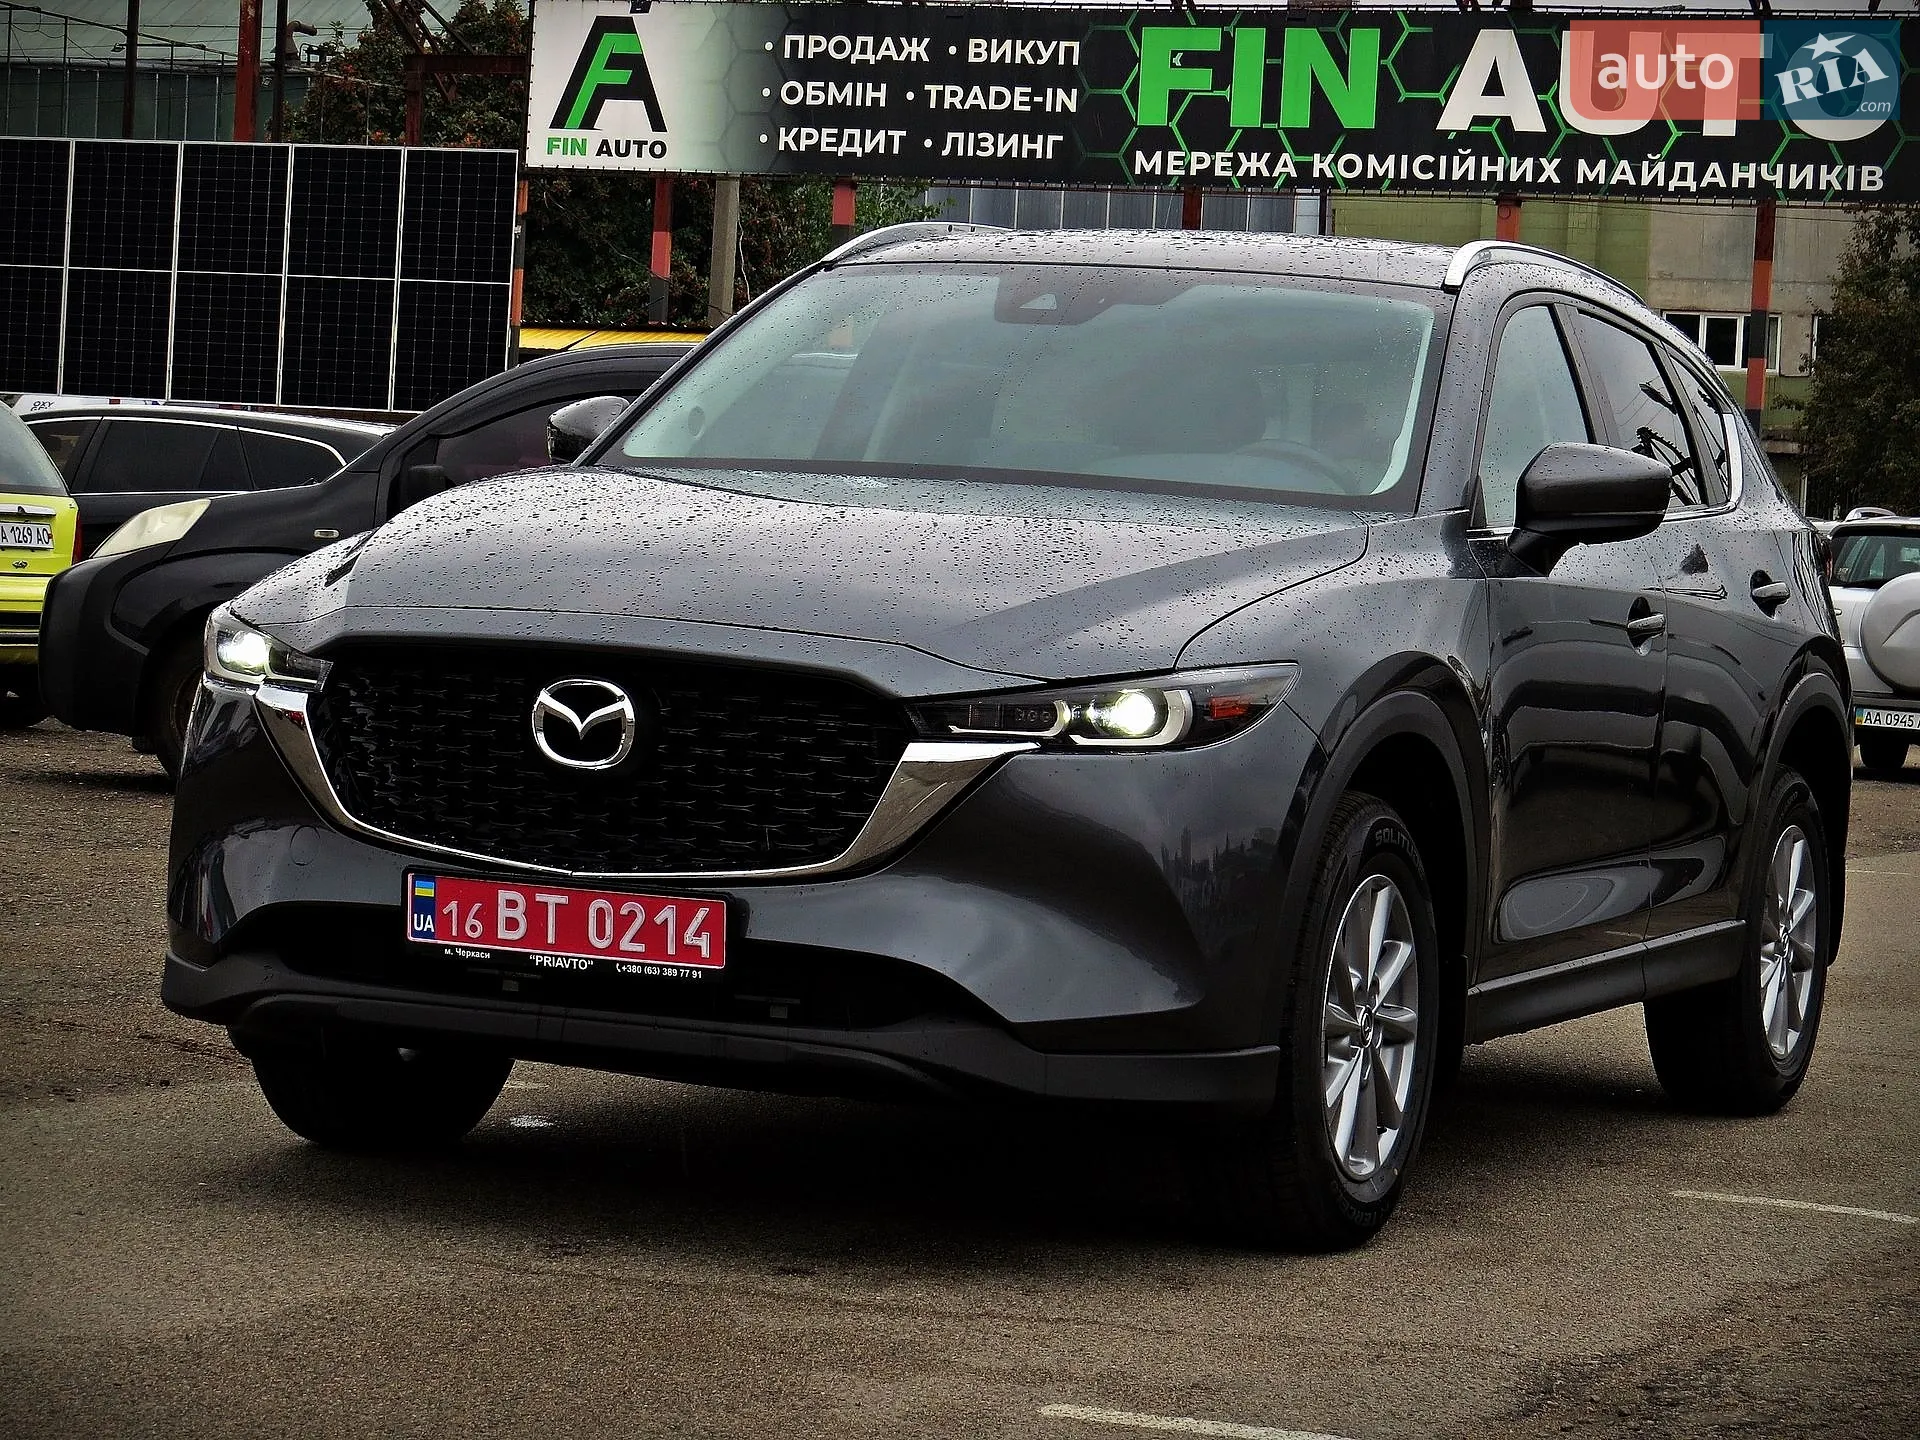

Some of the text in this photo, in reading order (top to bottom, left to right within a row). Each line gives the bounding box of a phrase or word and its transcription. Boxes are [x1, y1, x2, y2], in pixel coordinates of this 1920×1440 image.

[783, 35, 930, 64] ПРОДАЖ
[967, 38, 1080, 66] ВИКУП
[780, 80, 888, 107] ОБМІН
[1136, 26, 1898, 141] FIN AUTO
[924, 84, 1078, 113] TRADE-IN
[547, 137, 668, 159] FIN AUTO
[778, 127, 907, 157] КРЕДИТ
[941, 131, 1064, 160] ЛІЗИНГ
[1134, 149, 1885, 192] МЕРЕЖА КОМІСІЙНИХ МАЙДАНЧИКІВ
[10, 526, 32, 544] 1269
[1864, 711, 1882, 725] AA
[1886, 713, 1914, 727] 0945
[413, 913, 435, 932] UA
[443, 889, 711, 958] 16 BT 0214
[455, 947, 490, 959] Черкаси
[621, 964, 642, 974] +380
[644, 965, 660, 975] (63)
[679, 968, 690, 978] 77
[691, 970, 702, 979] 91
